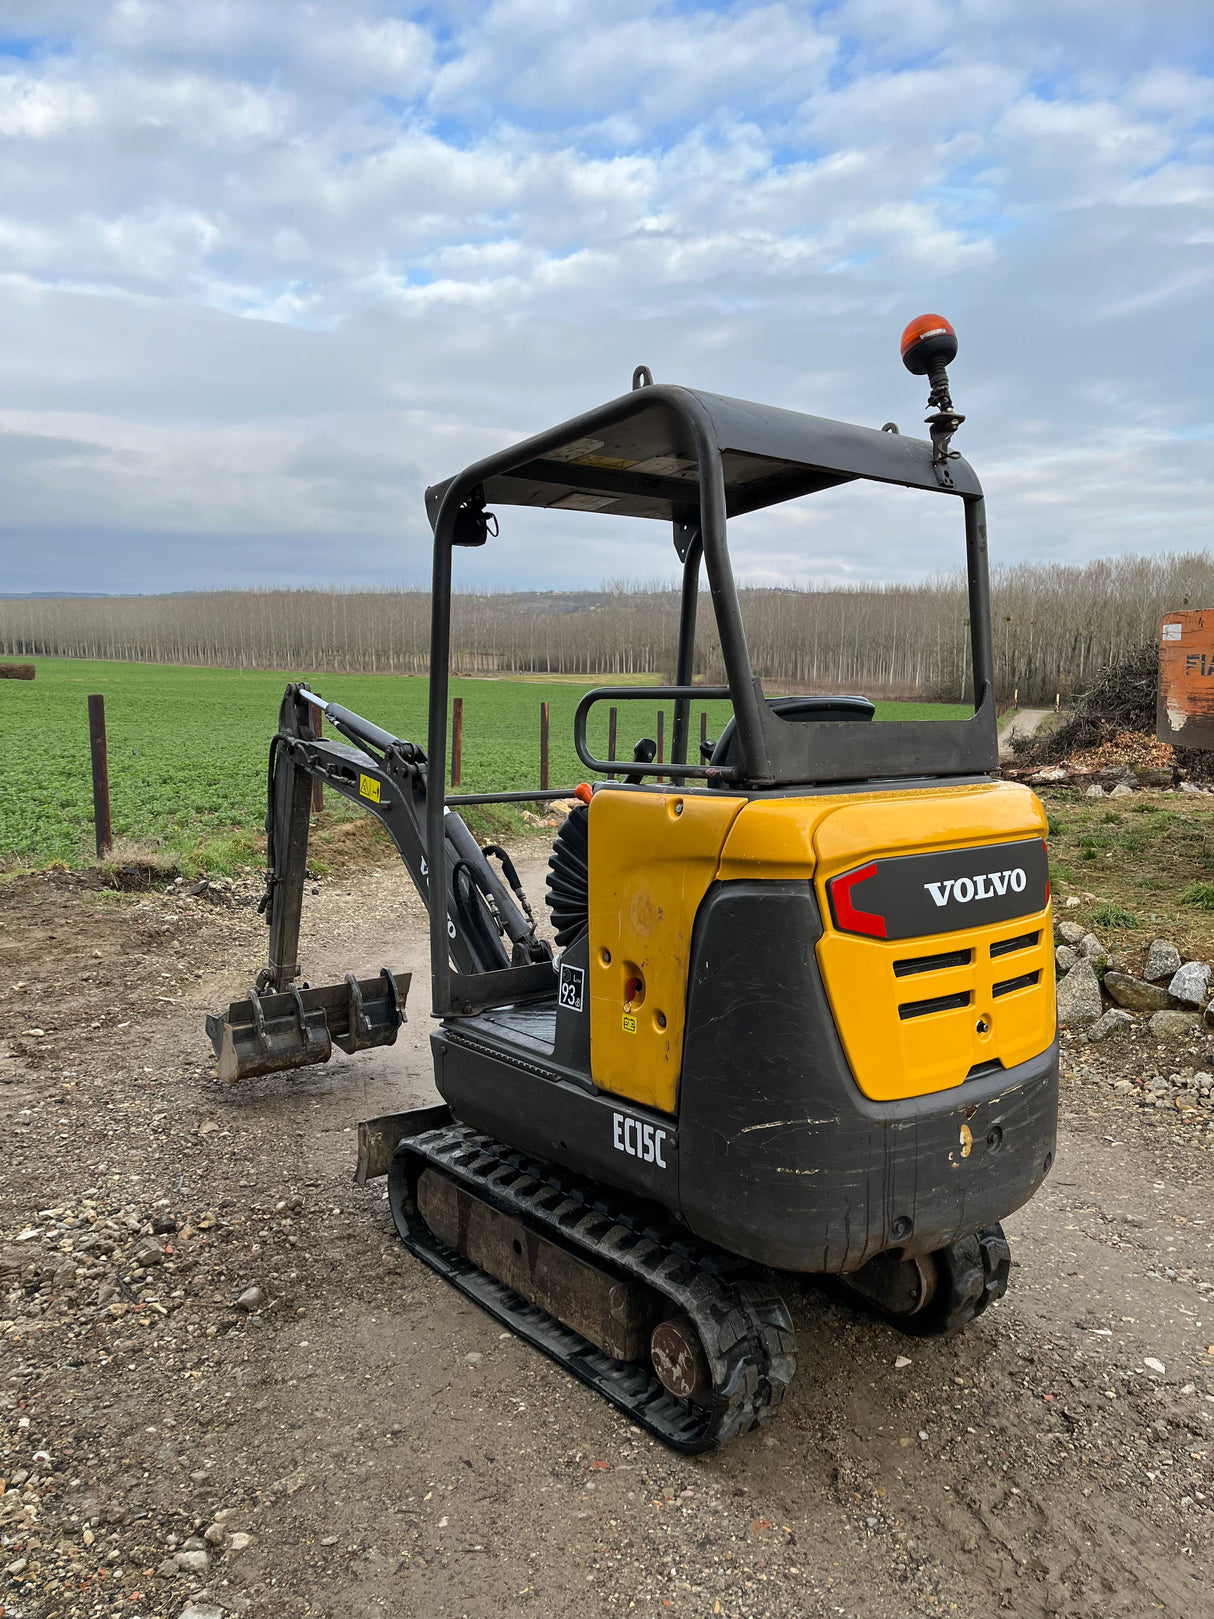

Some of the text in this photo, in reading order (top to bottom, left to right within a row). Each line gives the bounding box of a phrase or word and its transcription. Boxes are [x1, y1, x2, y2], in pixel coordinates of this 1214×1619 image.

[923, 868, 1027, 907] VOLVO
[562, 983, 576, 1005] 93
[612, 1112, 667, 1169] EC15C
